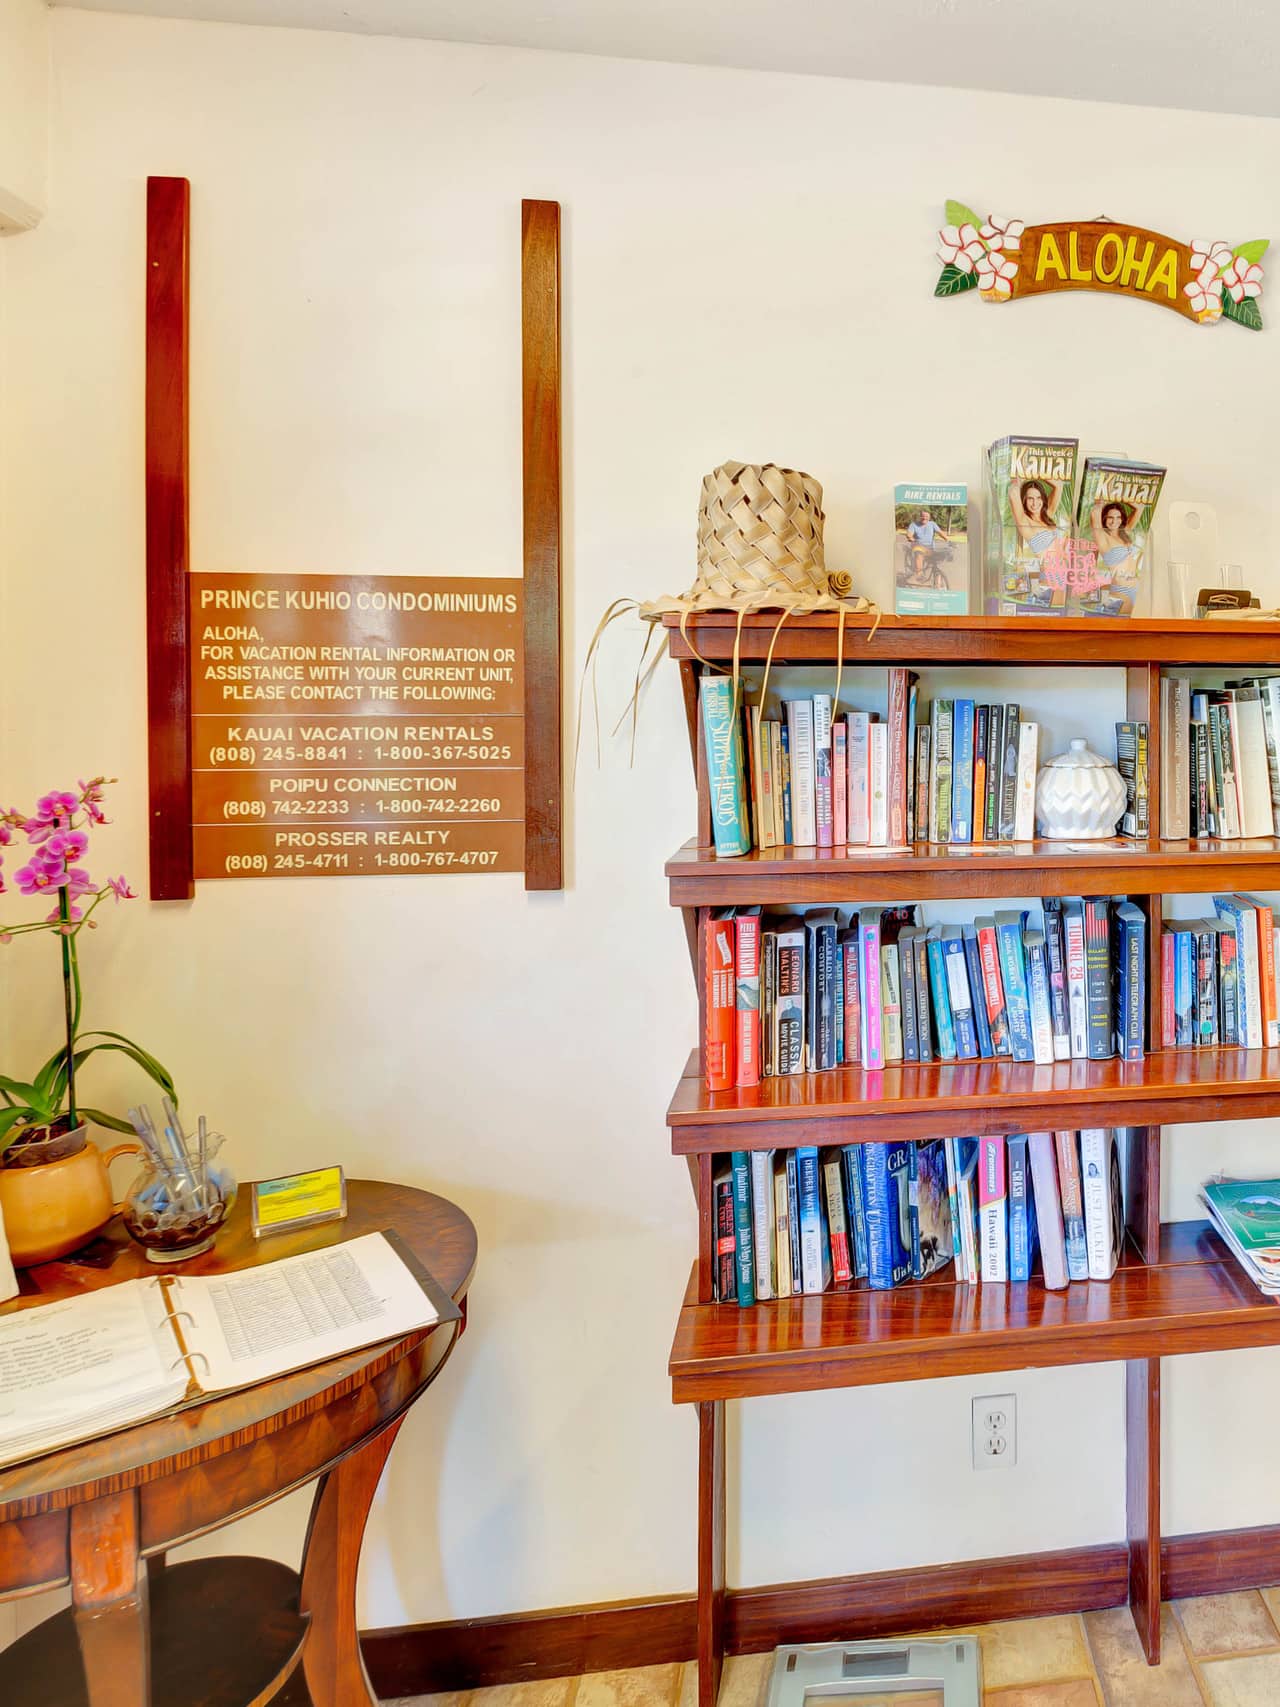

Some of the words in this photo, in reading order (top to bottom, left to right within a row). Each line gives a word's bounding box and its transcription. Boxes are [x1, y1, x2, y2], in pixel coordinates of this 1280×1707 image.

[1035, 231, 1178, 300] ALOHA
[1010, 446, 1073, 480] Kauai
[1096, 471, 1157, 503] Kauai
[201, 589, 279, 609] PRINCE
[285, 591, 351, 610] KUHIO
[356, 592, 517, 614] CONDOMINIUMS
[203, 626, 264, 642] ALOHA,
[201, 646, 233, 661] FOR
[240, 646, 316, 661] VACATION
[320, 646, 382, 661] RENTAL
[386, 647, 489, 662] INFORMATION
[493, 648, 515, 662] OR
[205, 666, 304, 681] ASSISTANCE
[309, 666, 350, 681] WITH
[355, 666, 396, 681] YOUR
[402, 667, 475, 682] CURRENT
[479, 667, 514, 684] UNIT,
[223, 686, 286, 700] PLEASE
[290, 686, 364, 700] CONTACT
[369, 686, 398, 700] THE
[403, 686, 496, 701] FOLLOWING:
[228, 727, 293, 742] KAUAI
[300, 727, 398, 742] VACATION
[404, 726, 494, 741] RENTALS
[209, 747, 256, 765] (808)
[263, 746, 348, 762] 245-8841
[374, 746, 511, 761] 1-800-367-5025
[270, 778, 328, 792] POIPU
[334, 777, 458, 792] CONNECTION
[223, 801, 266, 818] (808)
[272, 800, 349, 814] 742-2233
[375, 798, 501, 812] 1-800-742-2260
[712, 775, 738, 827] HEROES
[275, 832, 368, 847] PROSSER
[374, 830, 450, 845] REALTY
[225, 855, 268, 872] (808)
[274, 854, 349, 869] 245-4711
[374, 852, 499, 867] 1-800-767-4707
[740, 933, 755, 975] ROBINSON
[1070, 924, 1083, 962] TUNNEL
[1130, 937, 1138, 954] LAST
[847, 958, 857, 975] LARA
[983, 943, 996, 972] PATRICIA
[1130, 956, 1138, 978] NIGHT
[780, 950, 790, 994] MALTIN'S
[790, 949, 800, 993] LEONARD
[1070, 966, 1084, 982] 29
[847, 976, 857, 1005] ADRIAN
[1130, 982, 1138, 1022] TELEGRAPH
[780, 1022, 788, 1048] MOVIE
[1130, 1022, 1138, 1039] CLUB
[781, 1049, 789, 1074] GUIDE
[734, 1165, 748, 1203] Vladimir
[805, 1159, 814, 1192] DEEPER
[1012, 1170, 1023, 1197] CRASH
[1092, 1183, 1103, 1210] JUST
[725, 1196, 734, 1234] KRESLEY
[738, 1227, 750, 1246] Julia
[988, 1210, 998, 1248] Hawaii
[1094, 1216, 1105, 1259] JACKIE
[738, 1246, 751, 1262] May
[741, 1262, 752, 1284] Jonas
